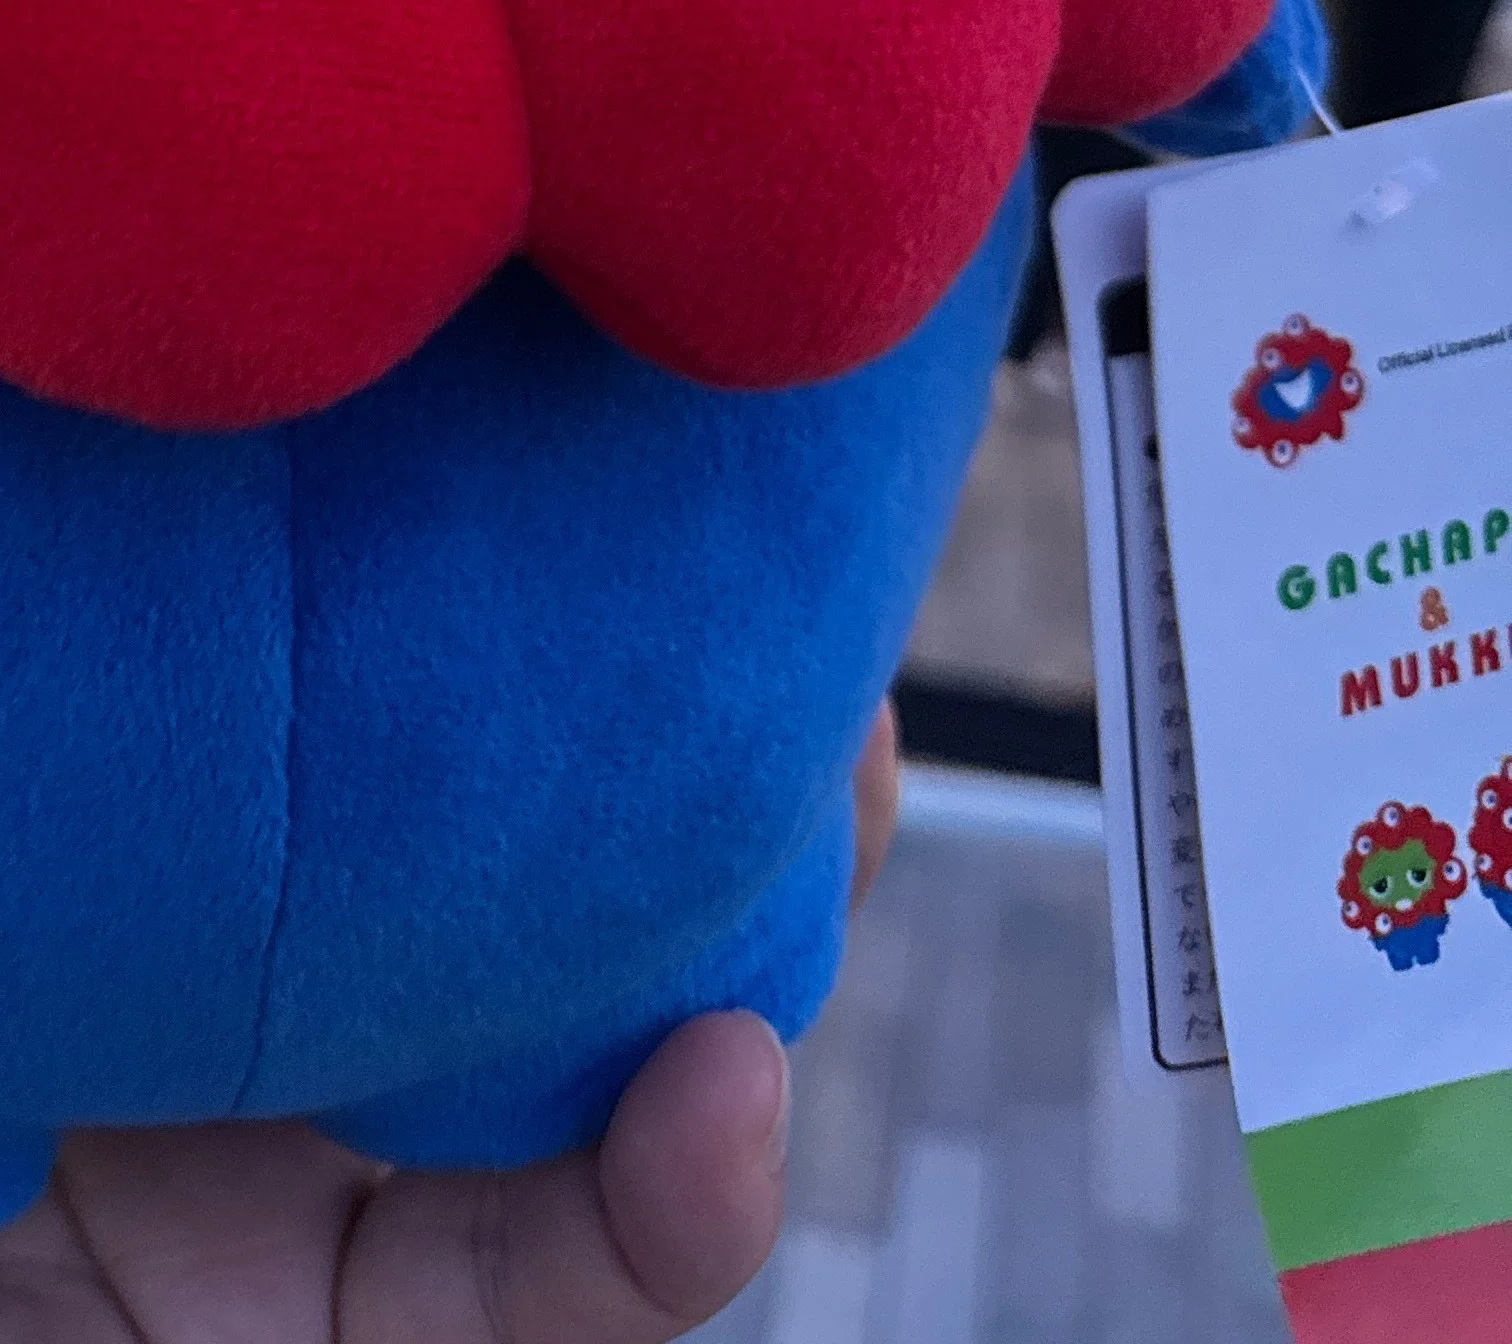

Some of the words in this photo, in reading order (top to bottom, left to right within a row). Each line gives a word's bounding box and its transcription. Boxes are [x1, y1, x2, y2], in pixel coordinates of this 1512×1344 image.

[1376, 345, 1434, 373] Official
[1276, 507, 1511, 612] GACHAP
[1419, 585, 1449, 632] &
